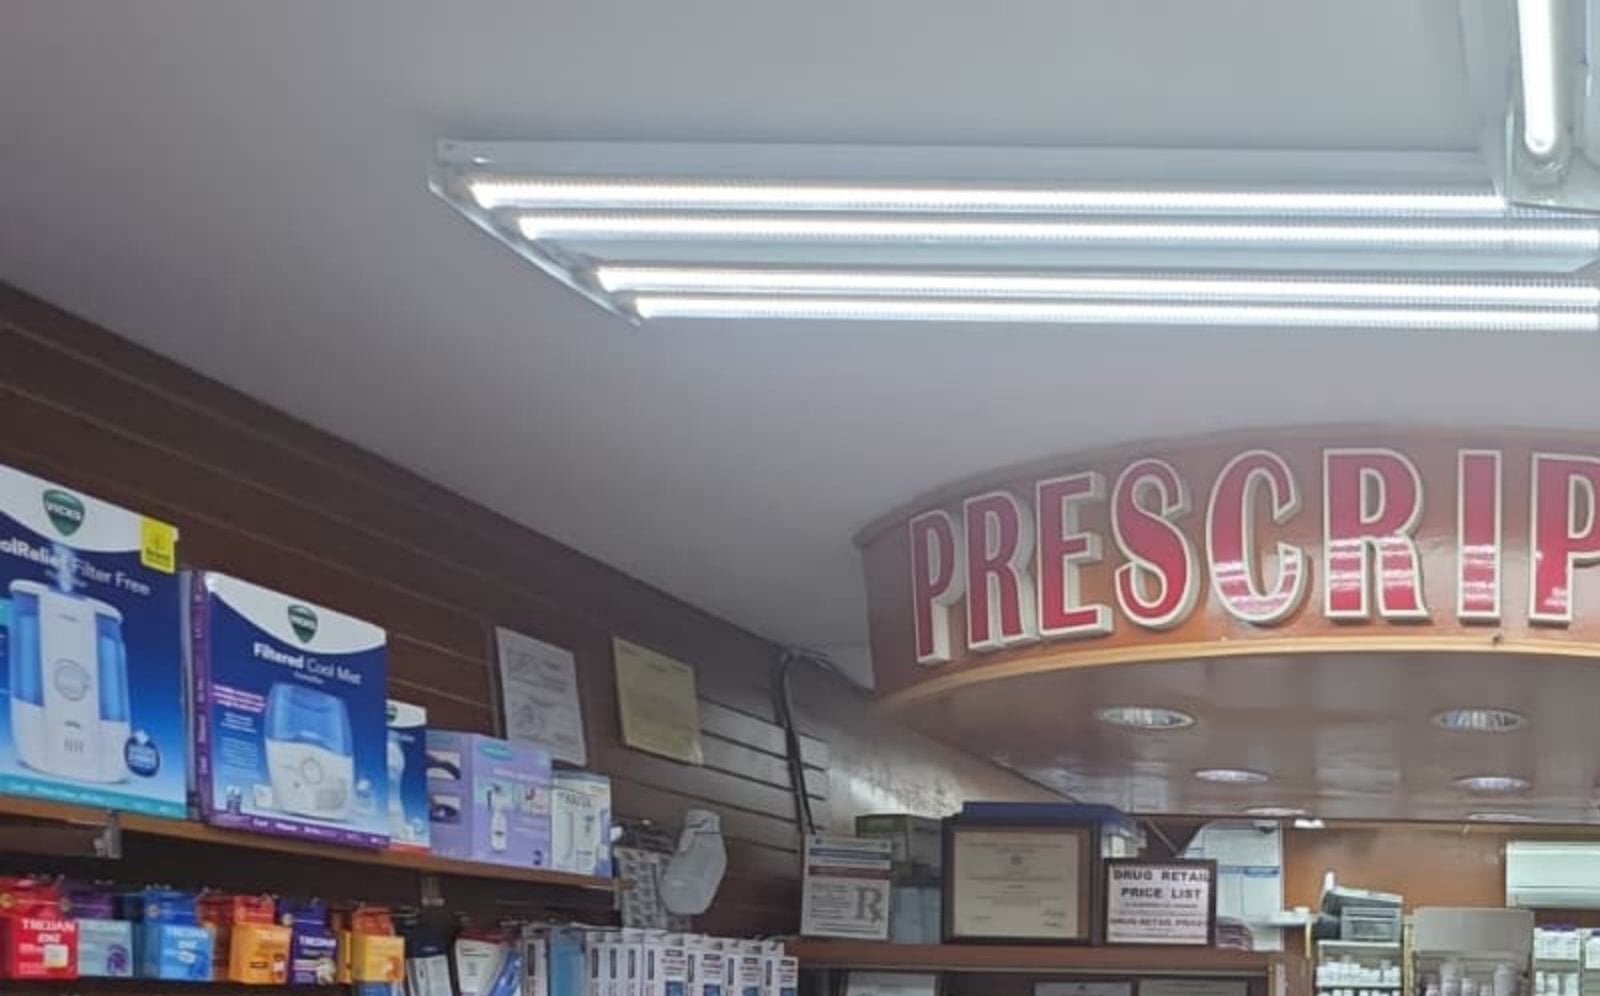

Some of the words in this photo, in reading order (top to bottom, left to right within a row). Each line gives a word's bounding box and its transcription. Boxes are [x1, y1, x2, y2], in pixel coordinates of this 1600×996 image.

[73, 559, 113, 583] Filter
[115, 571, 151, 596] Free
[253, 641, 304, 669] Filtered
[306, 658, 335, 677] Cool
[337, 667, 363, 686] Mist
[1113, 869, 1153, 881] DRUG
[1120, 887, 1163, 898] PRICE
[1171, 888, 1201, 900] LIST
[22, 918, 76, 933] TROJAN
